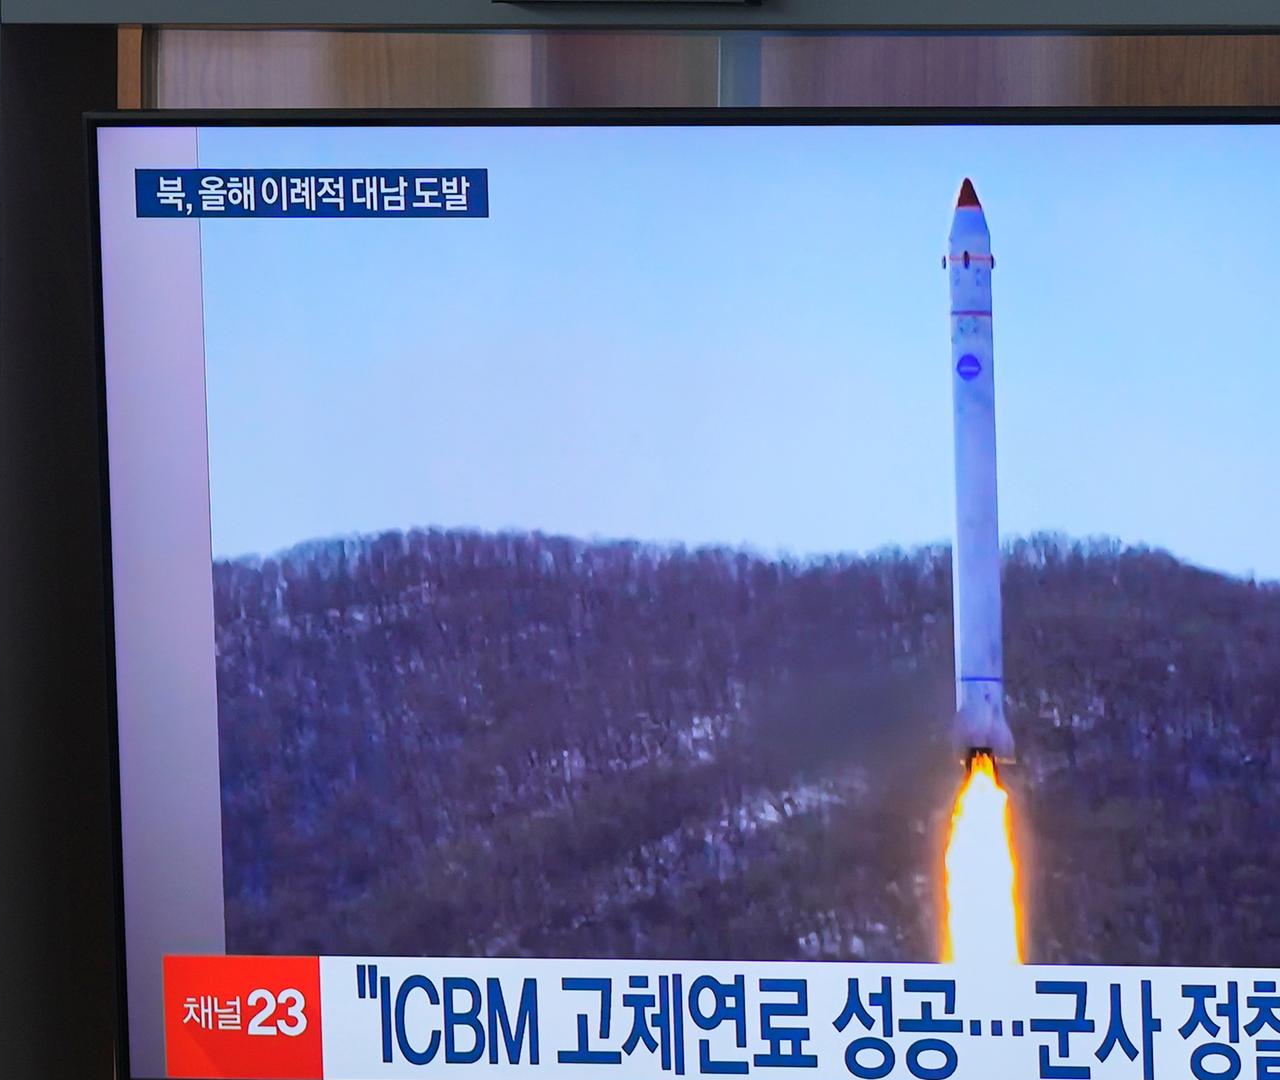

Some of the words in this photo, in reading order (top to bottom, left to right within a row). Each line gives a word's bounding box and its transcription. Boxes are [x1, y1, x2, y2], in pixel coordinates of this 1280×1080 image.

[156, 176, 194, 217] 북,
[198, 176, 256, 212] 올해
[261, 176, 346, 213] 이례적
[352, 176, 409, 212] 대남
[412, 176, 471, 212] 도발
[182, 995, 243, 1031] 채널
[247, 988, 309, 1038] 23
[355, 963, 541, 1067] "ICBM
[556, 973, 820, 1077] 고체연료
